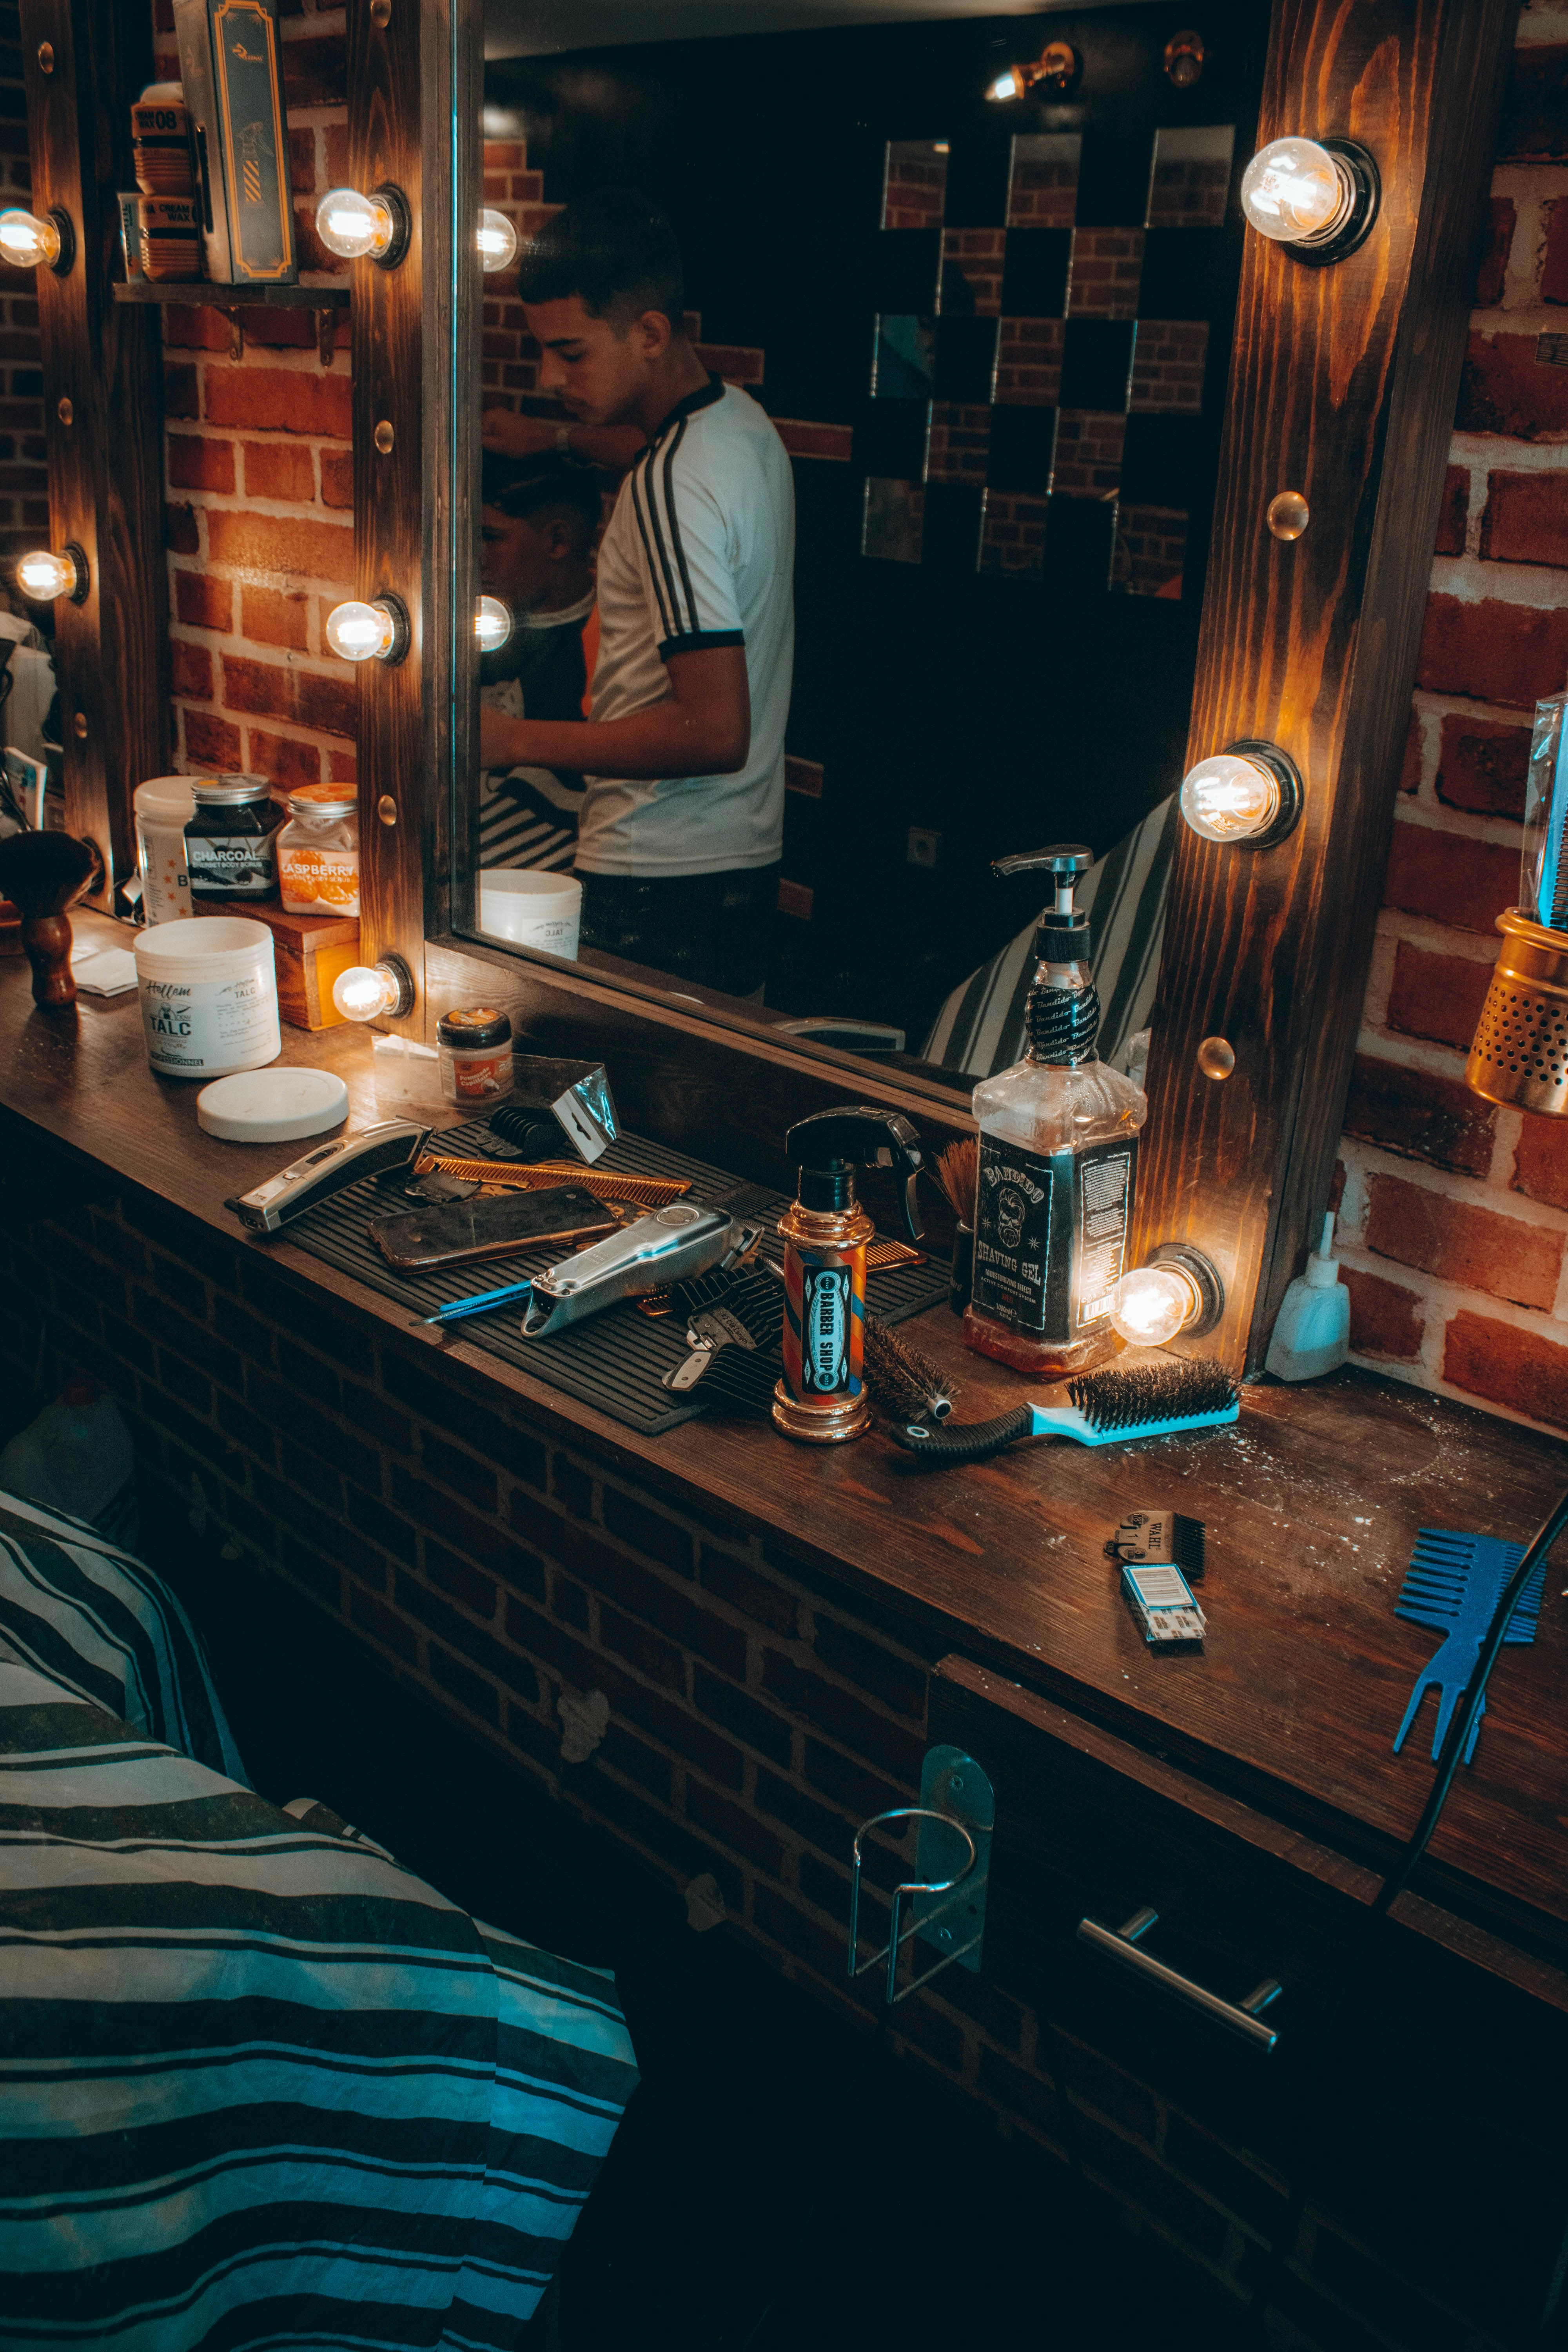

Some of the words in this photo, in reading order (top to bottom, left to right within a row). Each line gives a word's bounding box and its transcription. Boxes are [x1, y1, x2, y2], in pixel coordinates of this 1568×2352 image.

[156, 111, 177, 130] 08
[159, 203, 189, 212] CREAM
[167, 212, 189, 222] WAX
[193, 850, 260, 862] CHARCOAL
[234, 987, 256, 999] TALC
[1037, 996, 1072, 1009] Bandido
[150, 1016, 191, 1036] TALC
[1035, 1010, 1071, 1023] Bandido
[1036, 1024, 1071, 1036] Bandido
[982, 1165, 1045, 1204] BANDIDO
[978, 1240, 1018, 1272] SHAVING
[1022, 1262, 1041, 1286] GEL
[981, 1276, 996, 1286] ACTIVE
[1019, 1293, 1036, 1304] SYSTEM
[985, 1269, 1017, 1289] MOISTURIZING
[1017, 1283, 1032, 1295] EFFECT
[820, 1292, 835, 1336] BARBER
[820, 1342, 834, 1371] SHOP
[1148, 1522, 1161, 1550] WAHL
